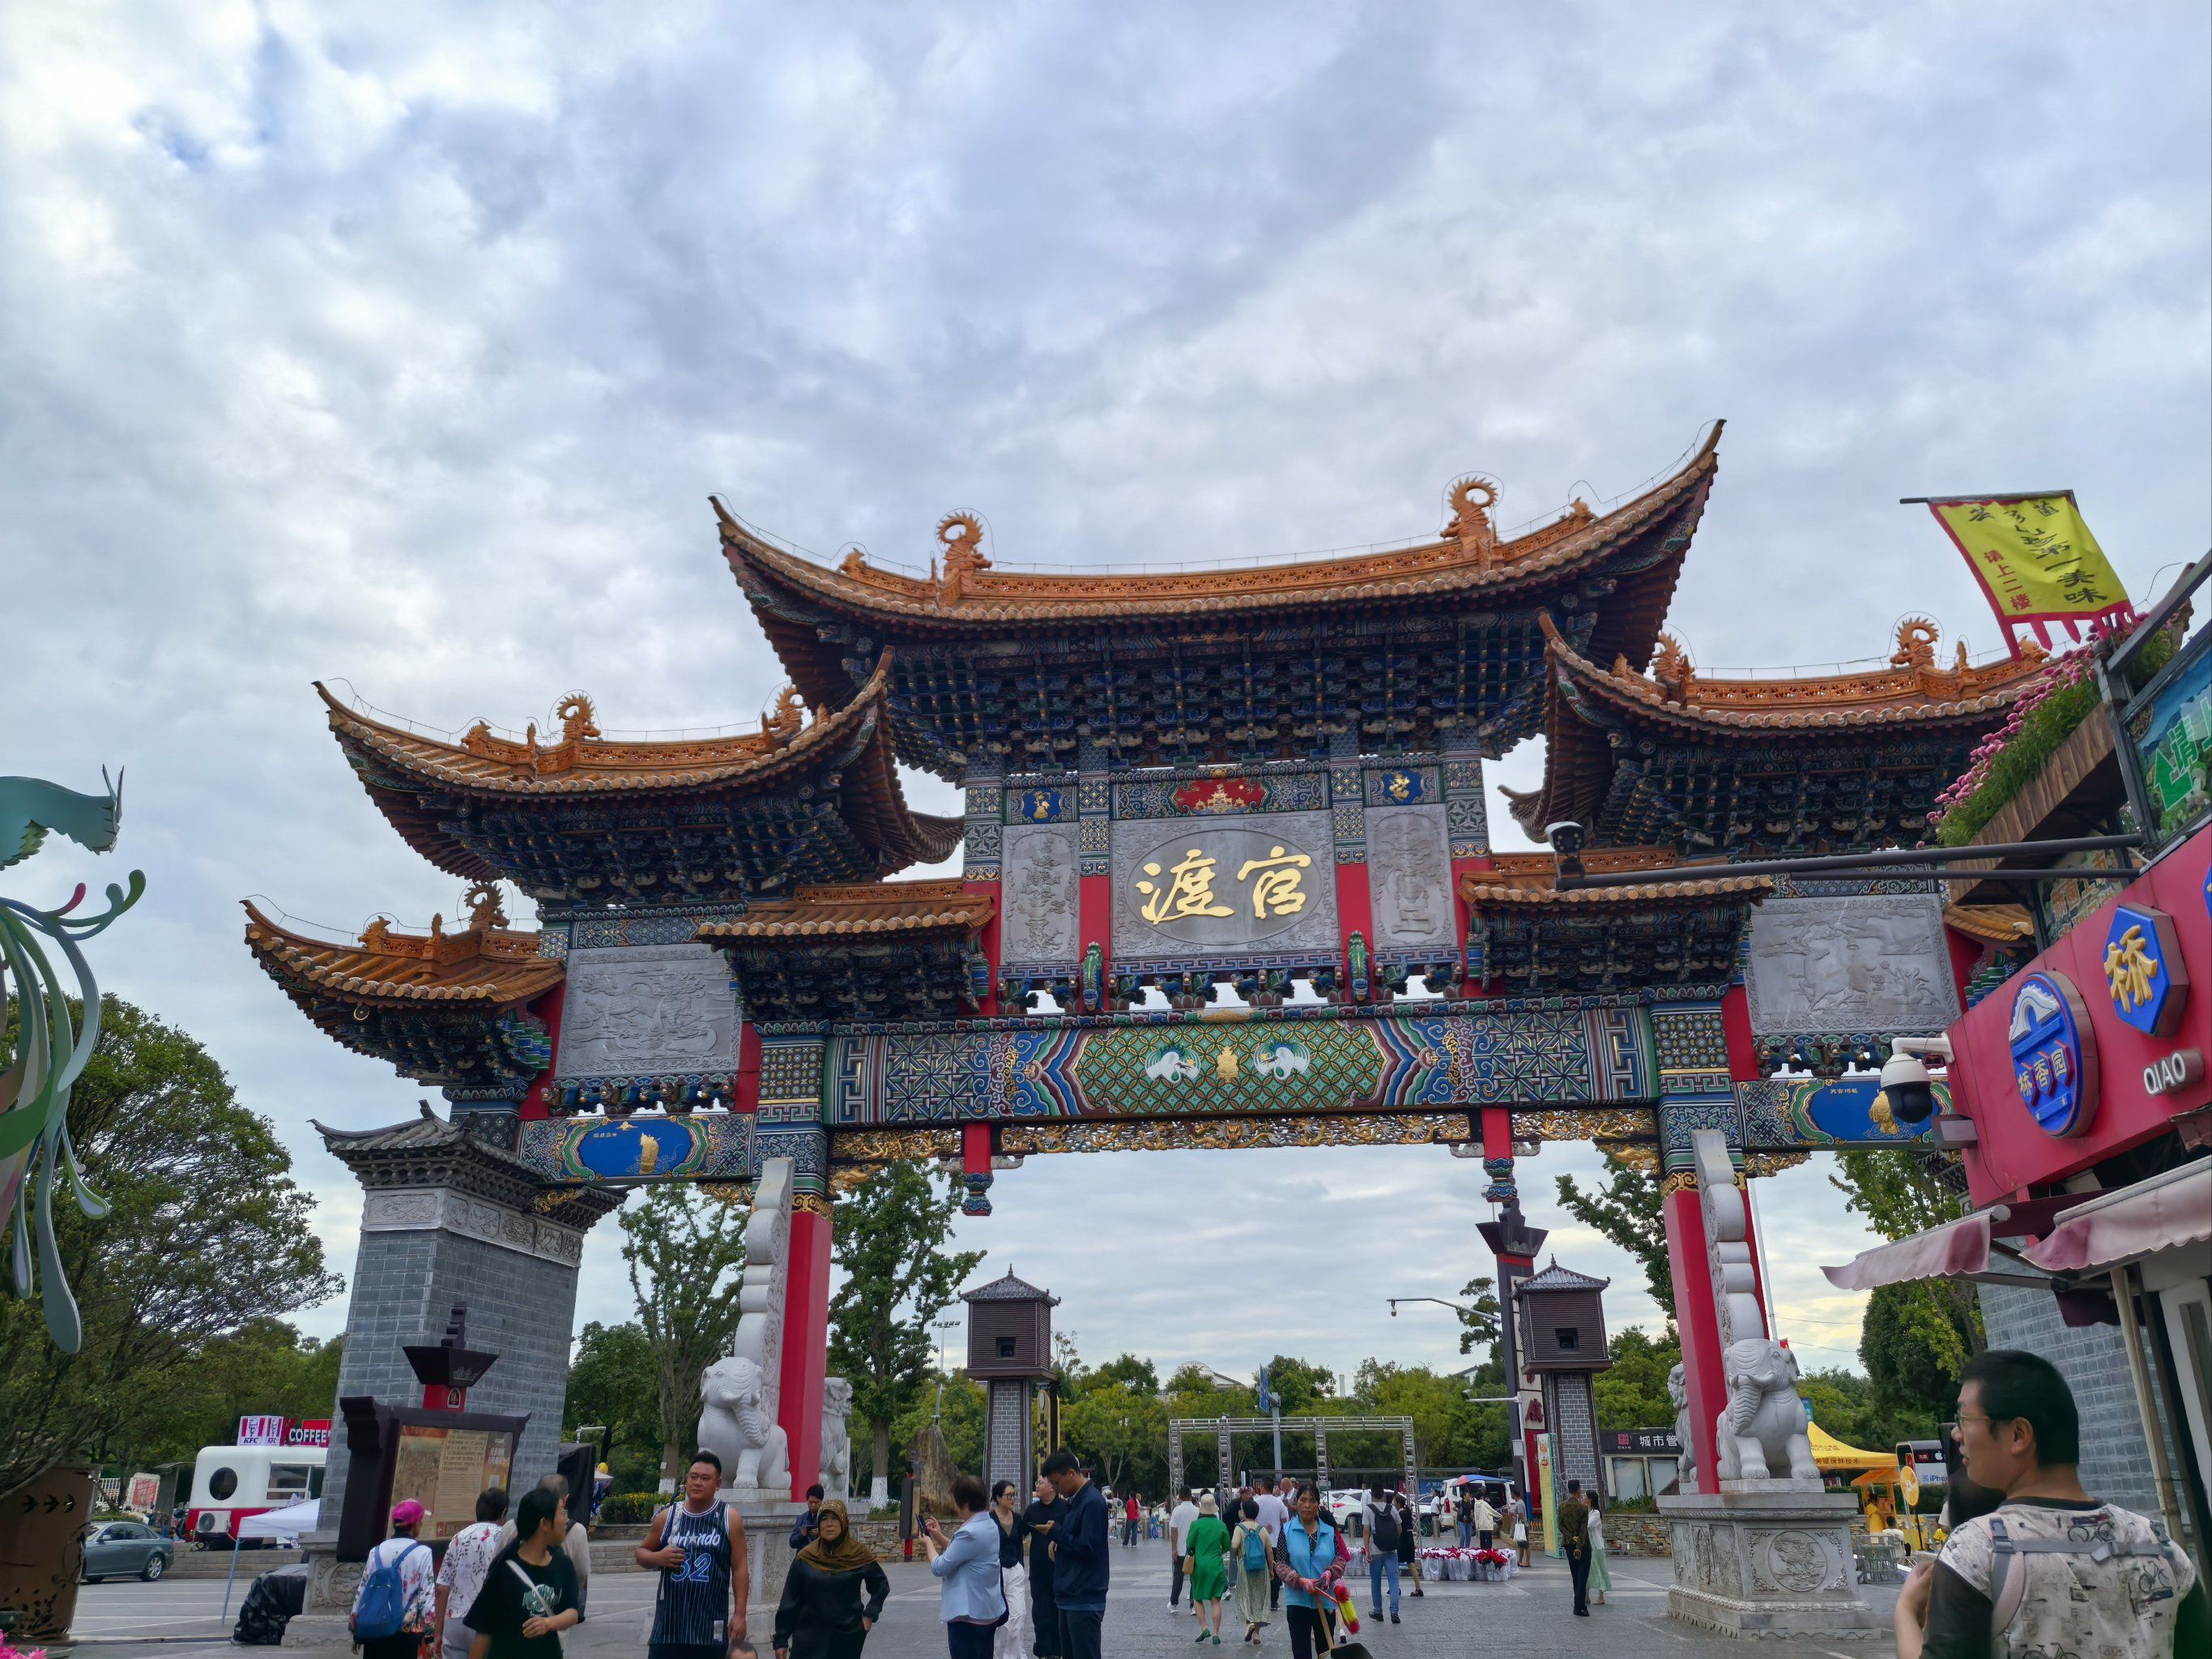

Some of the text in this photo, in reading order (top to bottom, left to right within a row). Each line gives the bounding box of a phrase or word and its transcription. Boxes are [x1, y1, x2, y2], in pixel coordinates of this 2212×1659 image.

[1984, 549, 2032, 611] 请上二楼
[2018, 1048, 2067, 1097] 桥香园
[2143, 1052, 2186, 1094] QIAO
[289, 1428, 326, 1443] COFFEE
[1639, 1433, 1677, 1447] 城市管
[670, 1552, 712, 1582] 32
